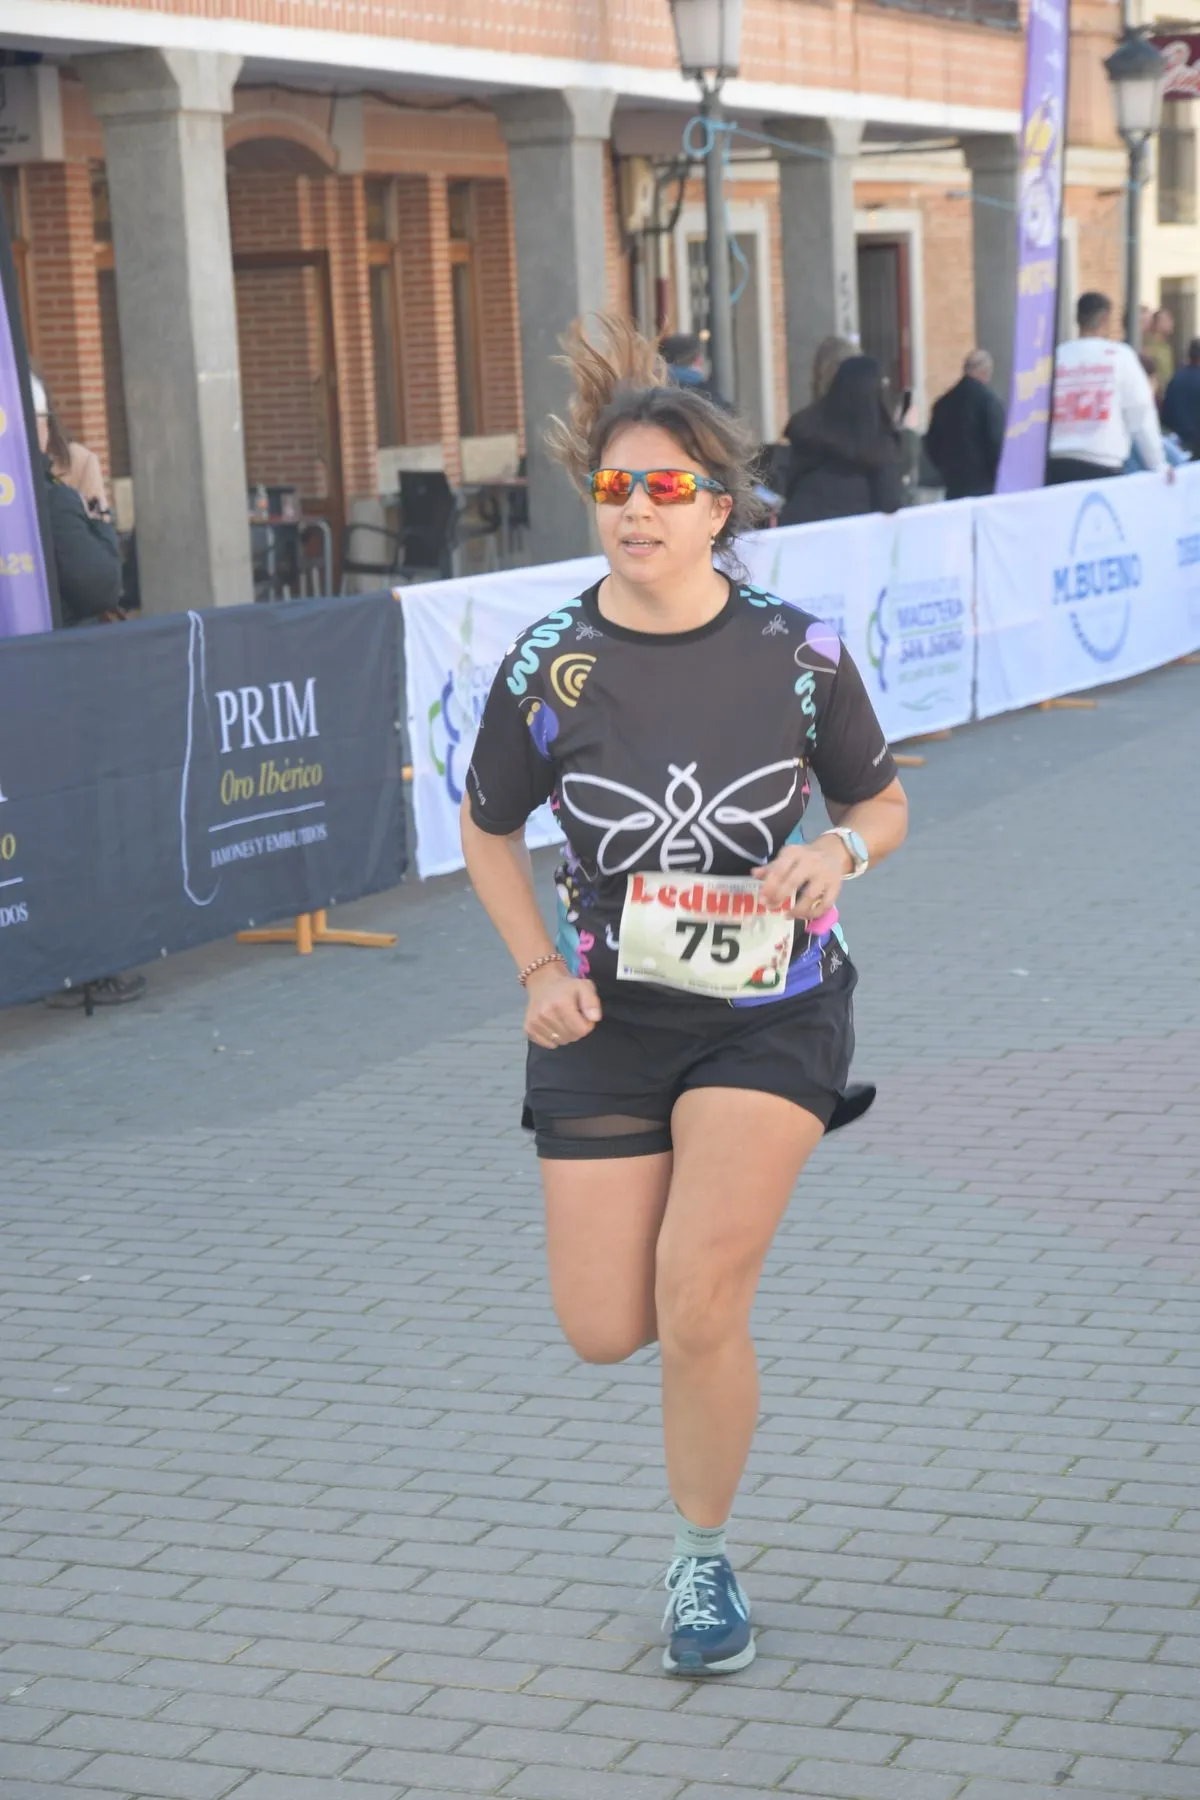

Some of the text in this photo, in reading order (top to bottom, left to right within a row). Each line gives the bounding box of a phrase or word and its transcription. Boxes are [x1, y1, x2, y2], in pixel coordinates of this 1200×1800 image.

[215, 677, 319, 753] PRIM
[221, 758, 323, 805] Oro Ibérico
[211, 823, 327, 868] JAMONES Y EMBUTIDOS
[675, 920, 742, 964] 75
